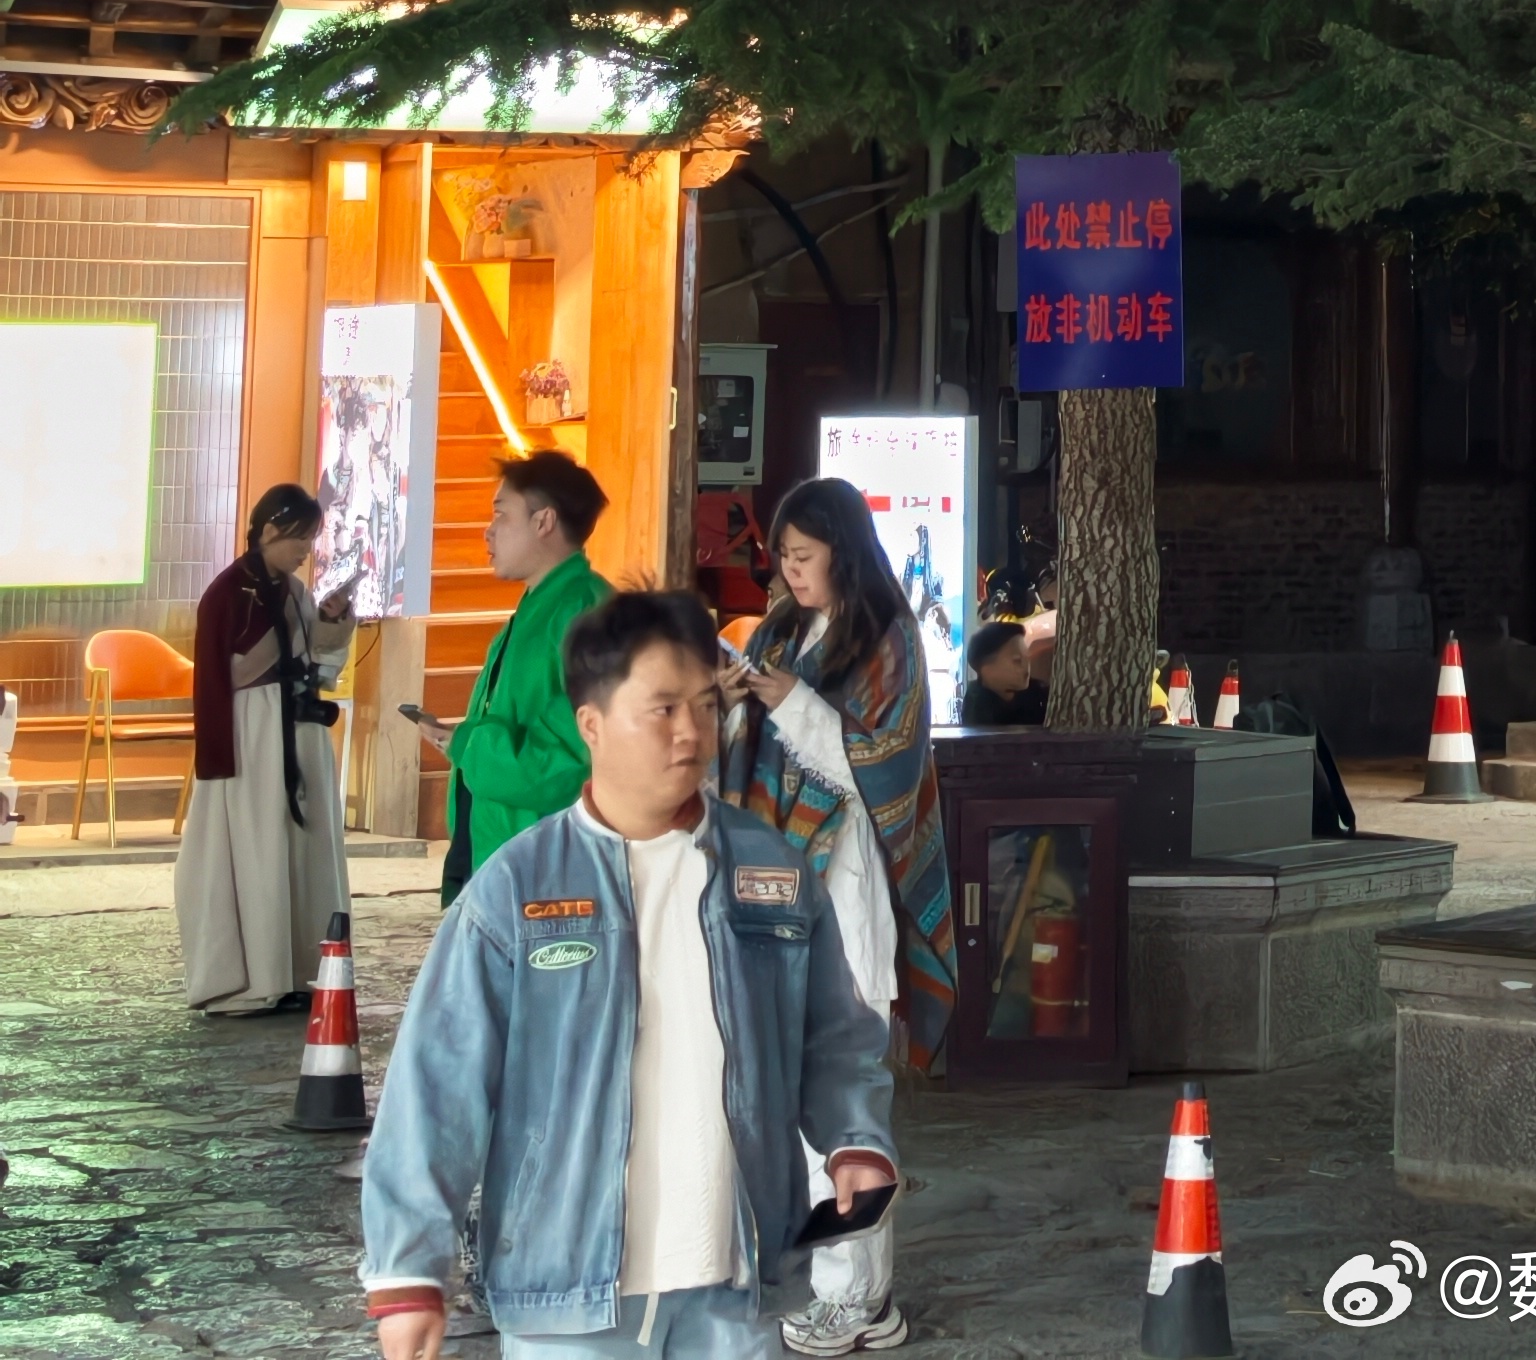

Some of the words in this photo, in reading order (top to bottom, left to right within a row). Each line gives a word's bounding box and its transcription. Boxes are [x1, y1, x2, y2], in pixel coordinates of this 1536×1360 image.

[1025, 199, 1173, 251] 此处禁止停
[1025, 291, 1174, 344] 放非机动车
